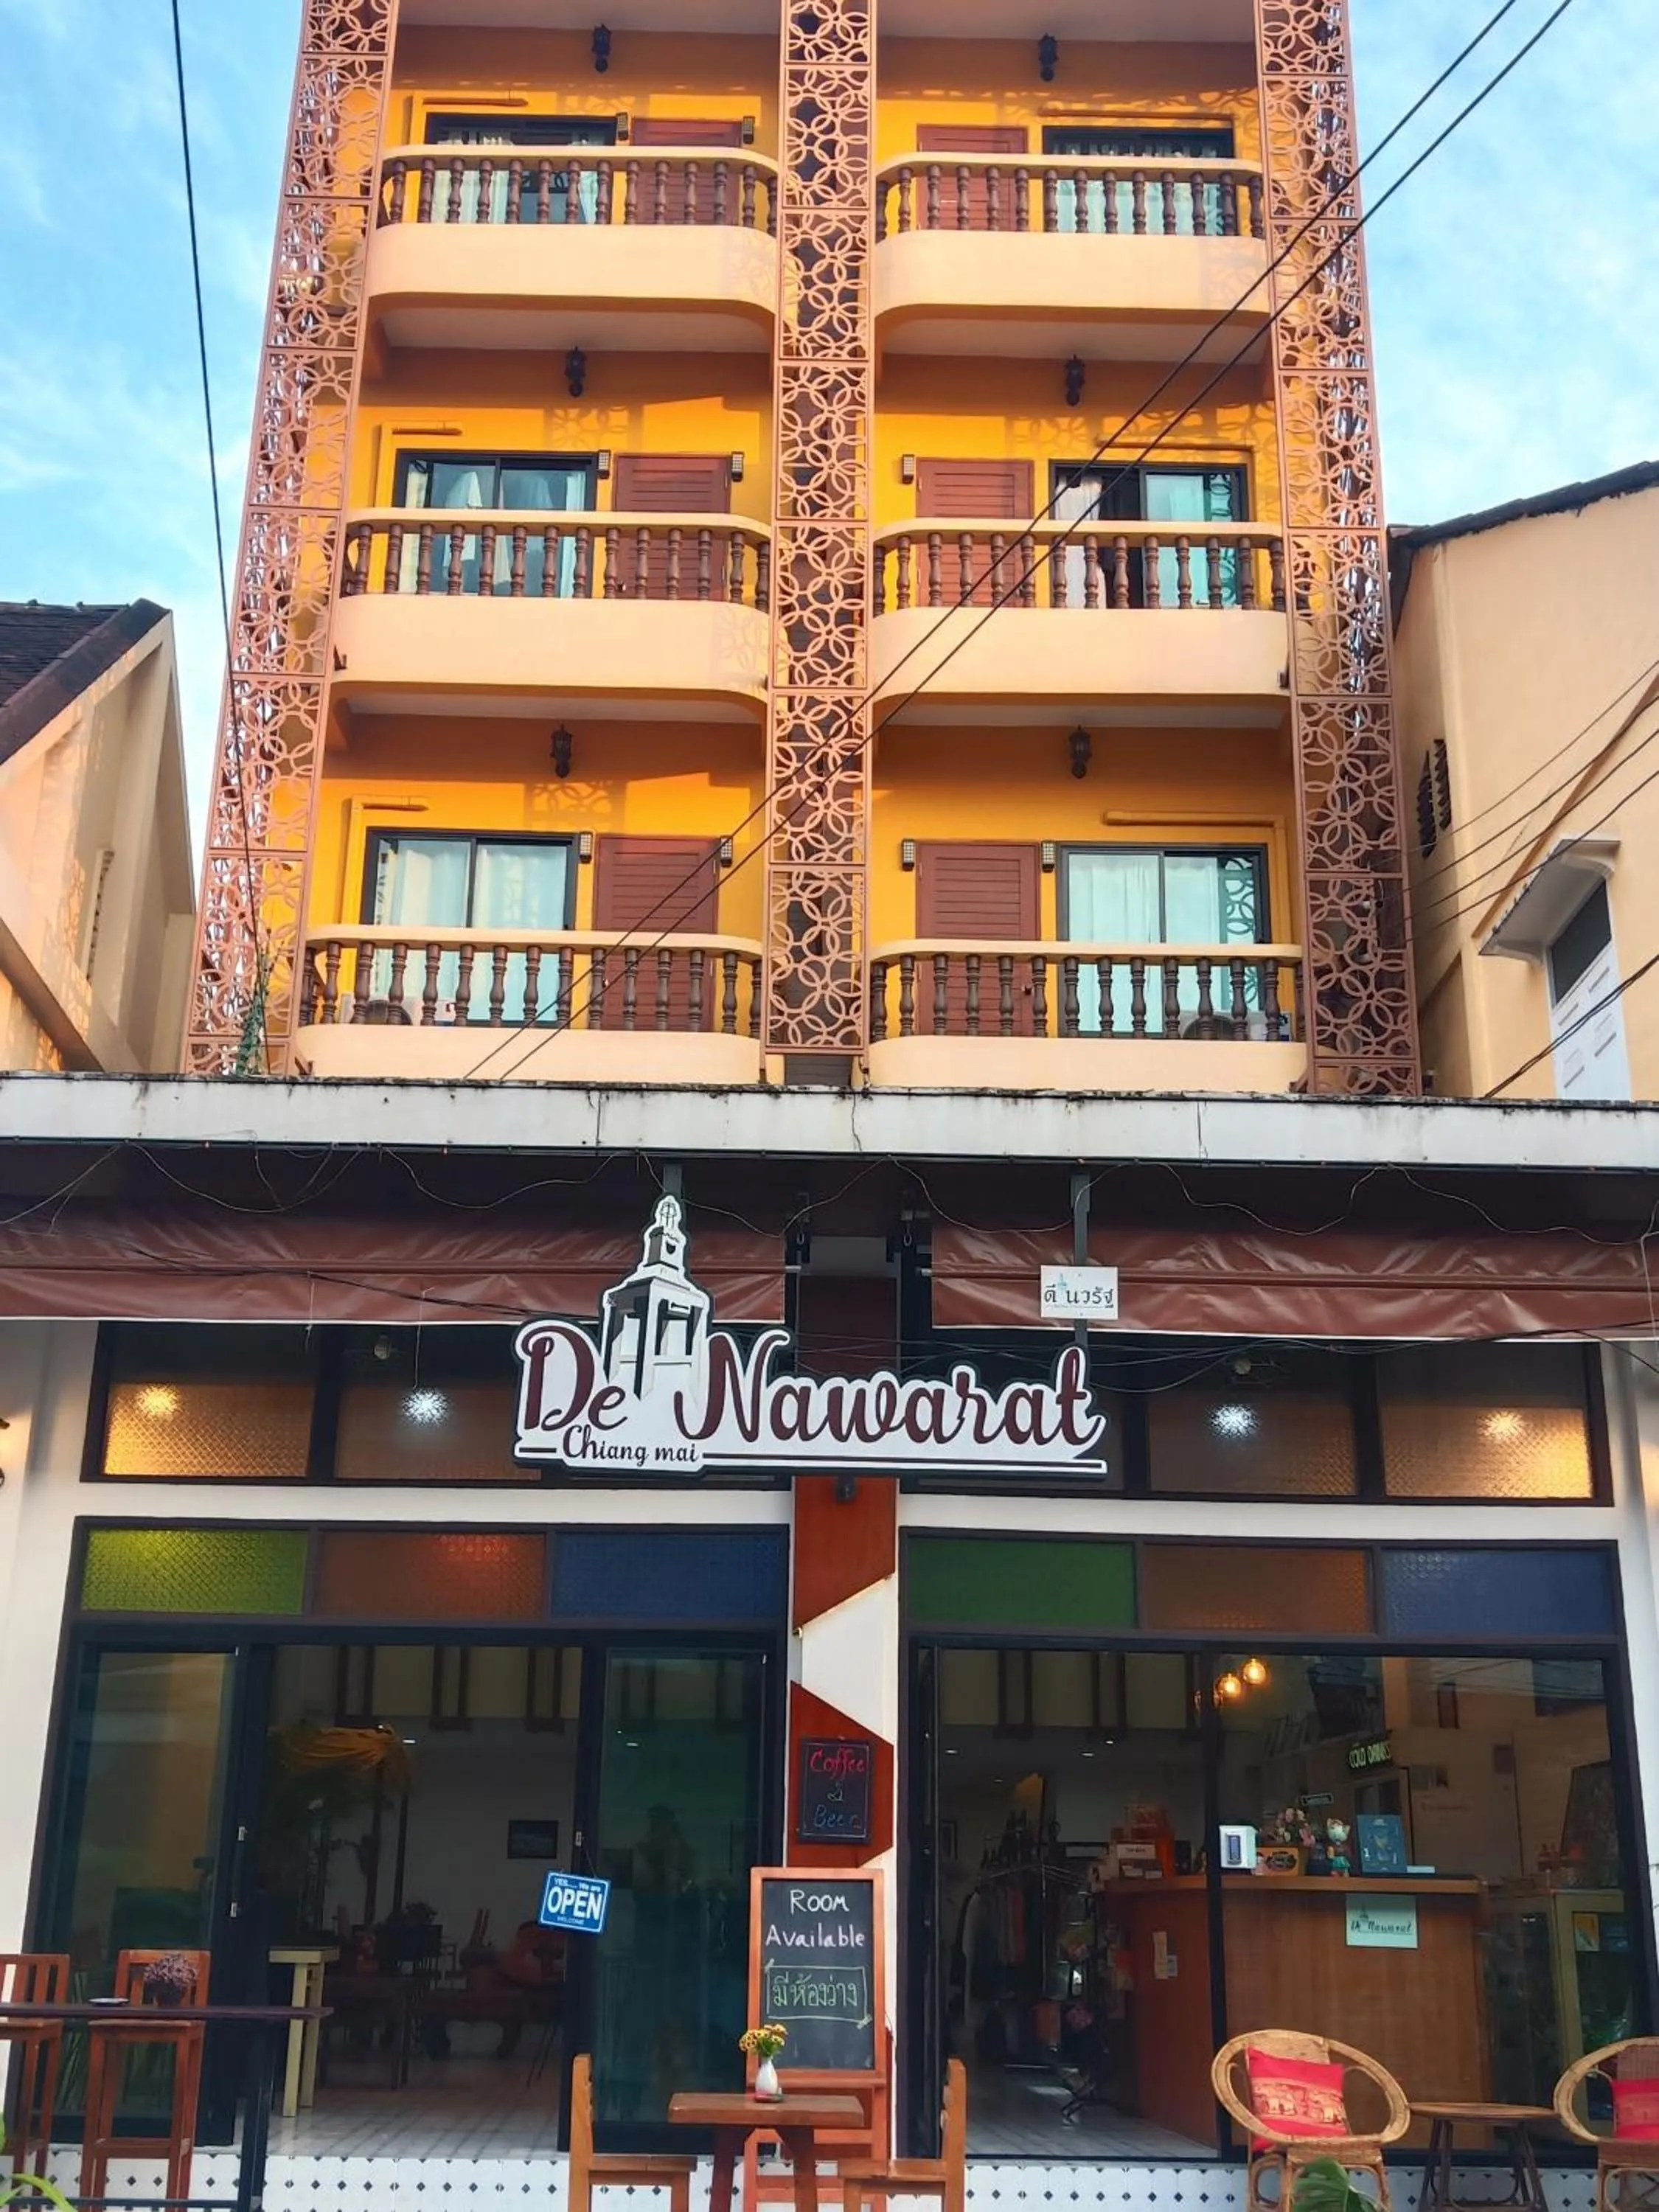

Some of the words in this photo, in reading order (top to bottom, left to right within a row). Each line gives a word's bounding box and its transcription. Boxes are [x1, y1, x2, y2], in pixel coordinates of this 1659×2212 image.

[521, 1325, 627, 1430] De
[673, 1333, 1105, 1445] Nawarat
[563, 1425, 649, 1467] Chiang
[655, 1443, 698, 1462] mai
[810, 1747, 866, 1781] Coffee
[547, 1886, 602, 1921] OPEN
[765, 1922, 865, 1948] Available
[773, 1971, 858, 2006] มีห้องว่าง
